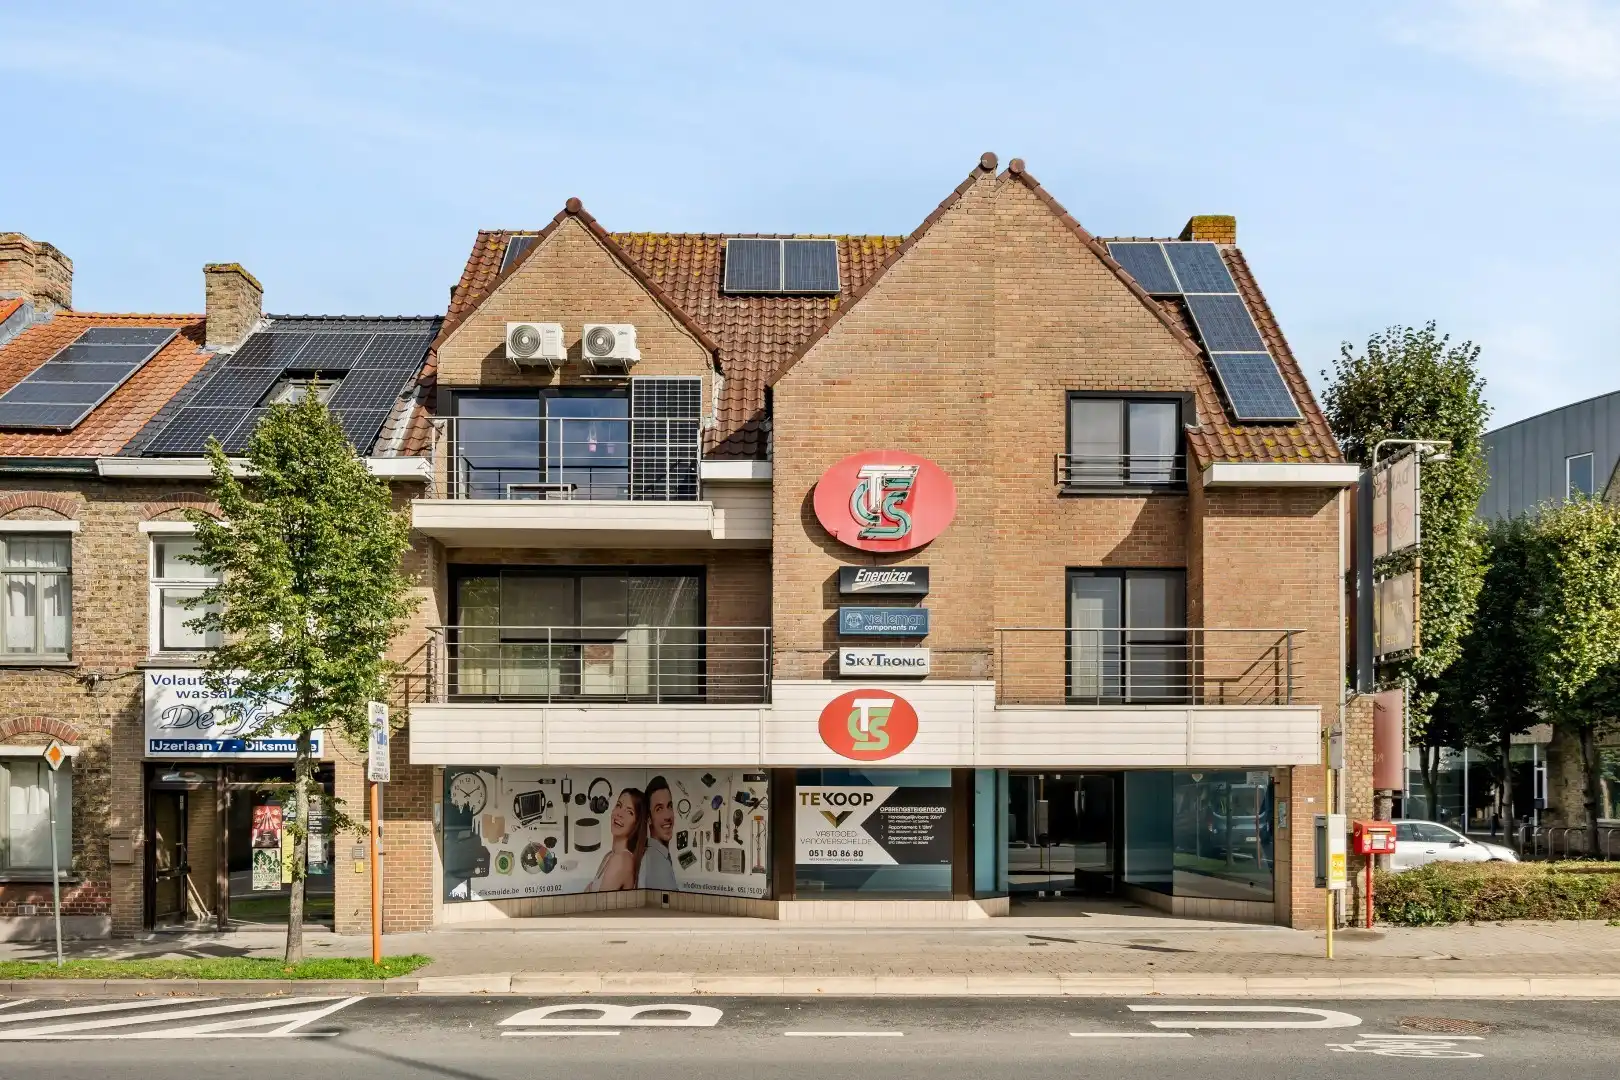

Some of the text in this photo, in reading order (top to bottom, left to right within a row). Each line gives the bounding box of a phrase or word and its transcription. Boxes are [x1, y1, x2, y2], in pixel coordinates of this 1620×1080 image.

[855, 569, 912, 584] Energizer
[865, 612, 925, 625] velleman
[160, 704, 214, 730] De
[151, 740, 213, 751] IJzerlaan
[216, 741, 224, 751] 7
[245, 740, 317, 751] Diksmue
[799, 792, 874, 806] TE KOOP
